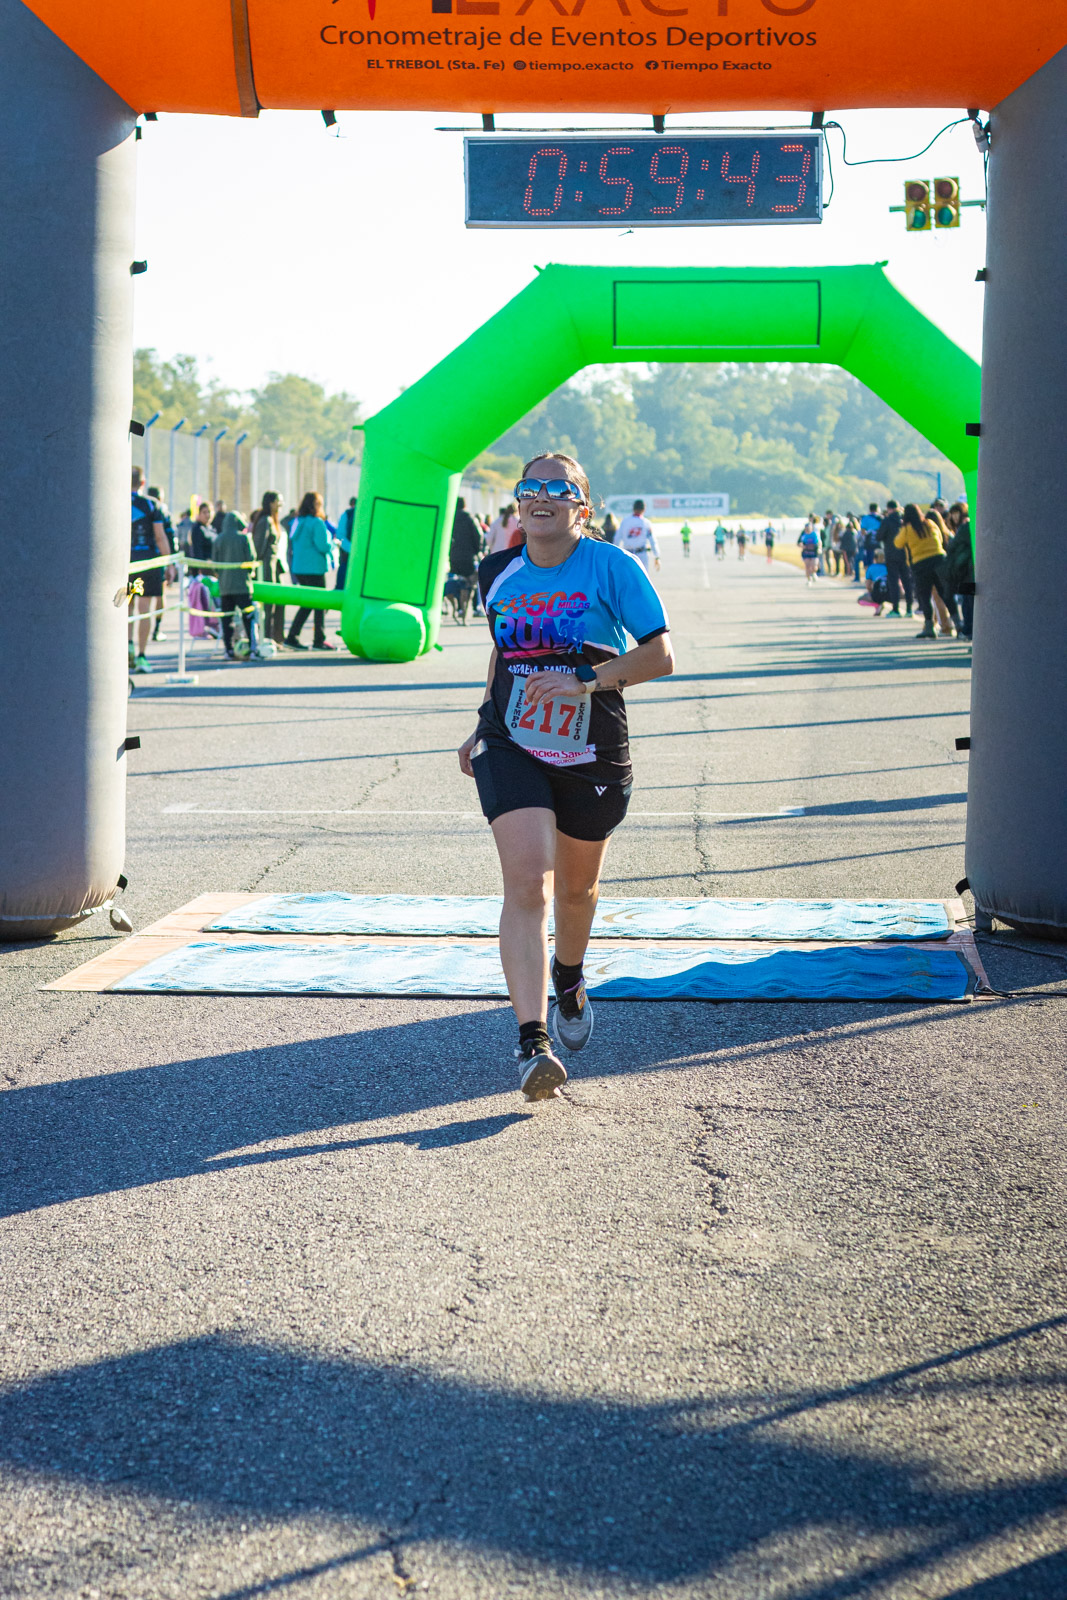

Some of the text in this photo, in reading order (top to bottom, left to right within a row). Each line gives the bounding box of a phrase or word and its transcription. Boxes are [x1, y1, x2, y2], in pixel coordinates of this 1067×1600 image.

[320, 25, 817, 51] Cronometraje de Eventos Deportivos
[367, 59, 505, 71] EL TREBOL (Sta. Fe)
[529, 61, 634, 72] tiempo.exacto
[661, 60, 772, 72] Tiempo Exacto
[523, 143, 811, 217] 0:59:43
[557, 601, 590, 609] MILLAS
[511, 689, 525, 729] TIEMPO
[518, 698, 577, 737] 217
[573, 702, 586, 741] EXACTO
